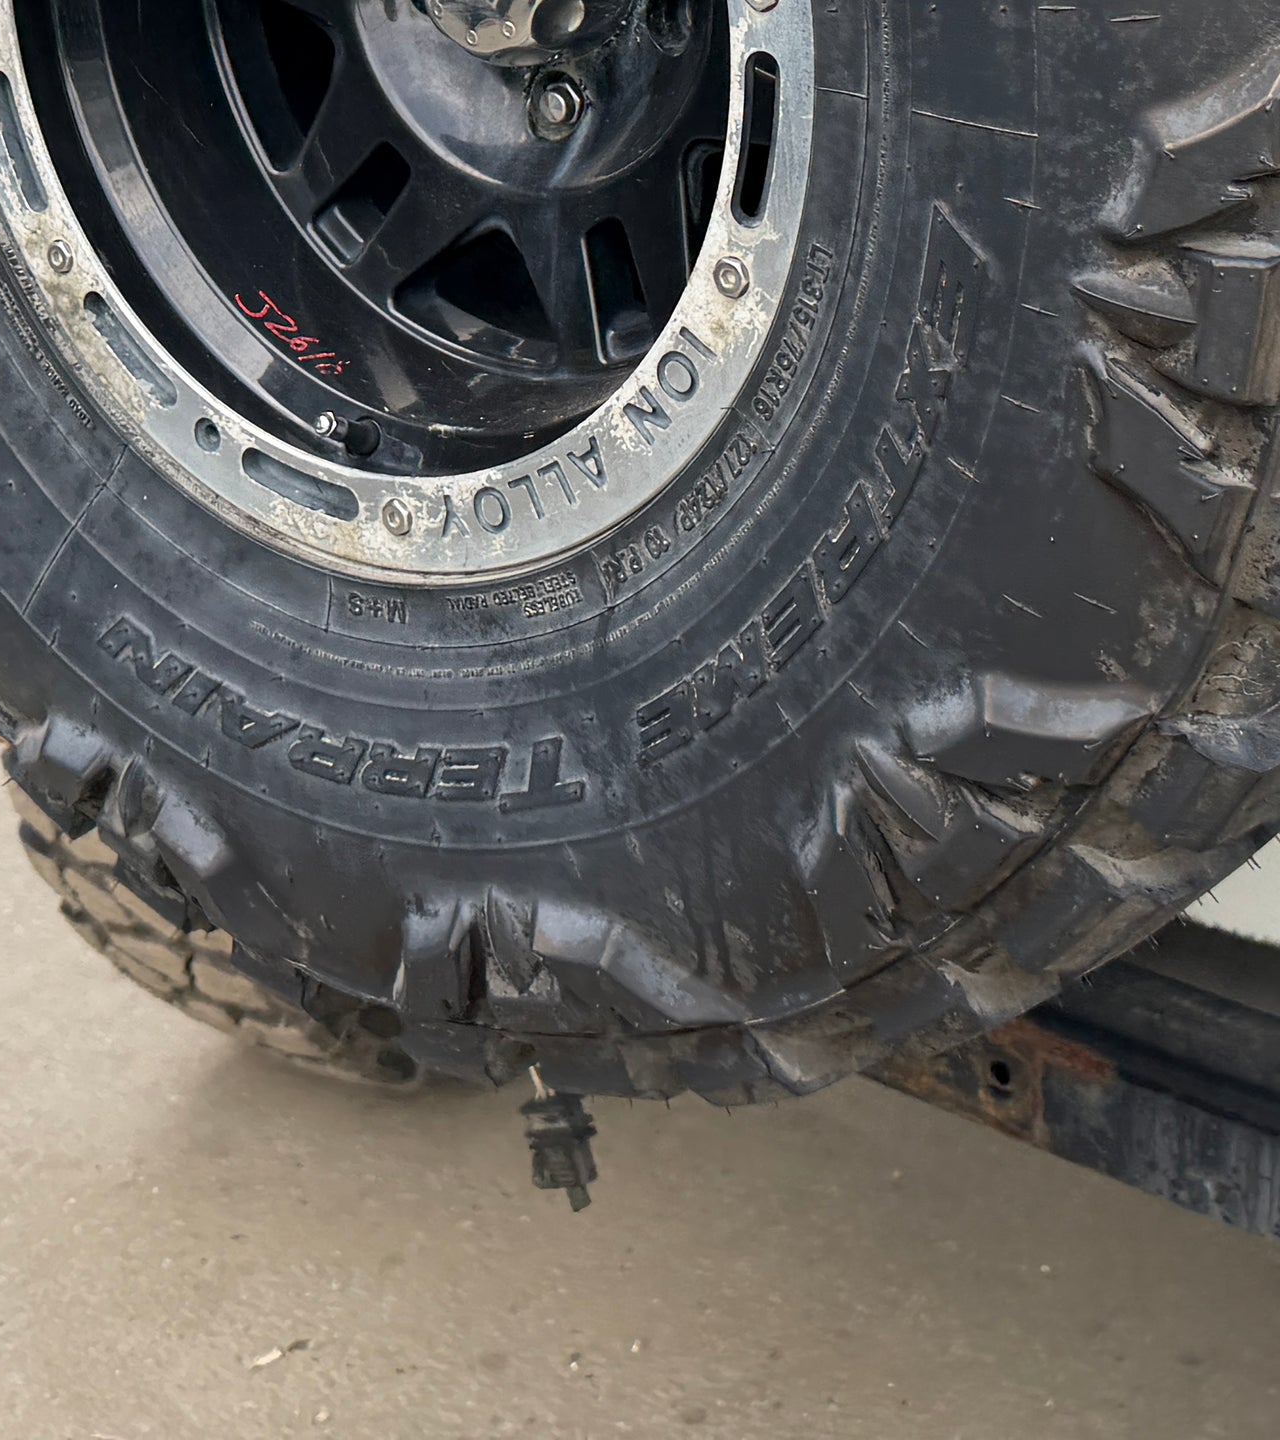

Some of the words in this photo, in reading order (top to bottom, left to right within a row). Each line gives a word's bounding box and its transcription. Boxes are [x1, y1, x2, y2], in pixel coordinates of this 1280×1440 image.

[749, 242, 836, 421] LT315/75R16
[621, 325, 719, 447] ION
[442, 435, 610, 540] ALLOY
[635, 199, 987, 762] EXTREME
[347, 592, 409, 625] M+S
[445, 594, 488, 611] RADIAL
[491, 584, 535, 606] BELTED
[523, 585, 583, 619] TUBELESS
[536, 569, 578, 592] STEEL
[96, 615, 585, 814] TERRAIN
